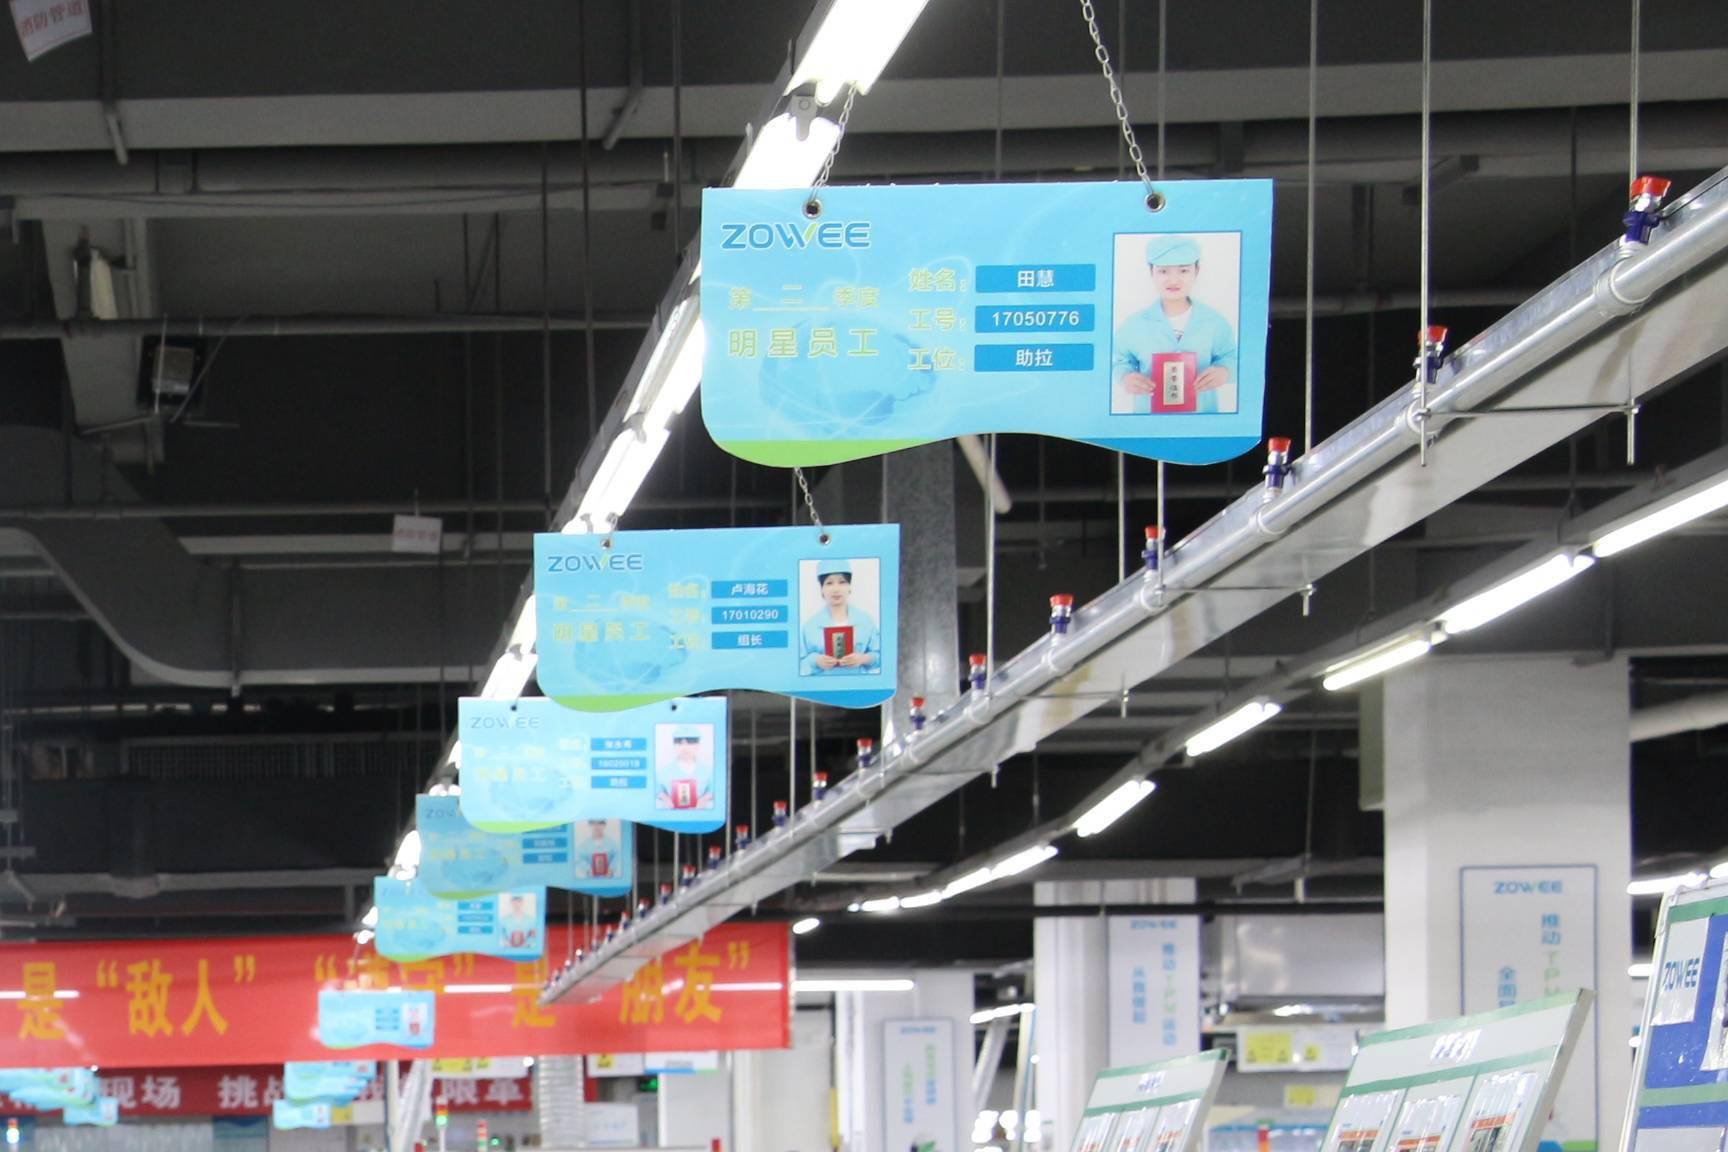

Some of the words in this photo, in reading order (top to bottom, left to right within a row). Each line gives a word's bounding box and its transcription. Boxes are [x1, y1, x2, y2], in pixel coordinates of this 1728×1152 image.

[721, 222, 872, 250] ZOWEE
[1016, 269, 1055, 289] 田慧
[991, 310, 1080, 328] 17050776
[728, 327, 880, 359] 明星员工
[1015, 348, 1054, 368] 助拉
[548, 554, 643, 572] ZOWEE
[722, 608, 780, 621] 17010290
[1494, 880, 1563, 895] ZOWEE
[1663, 957, 1700, 991] ZOWEE
[18, 961, 66, 1041] 是
